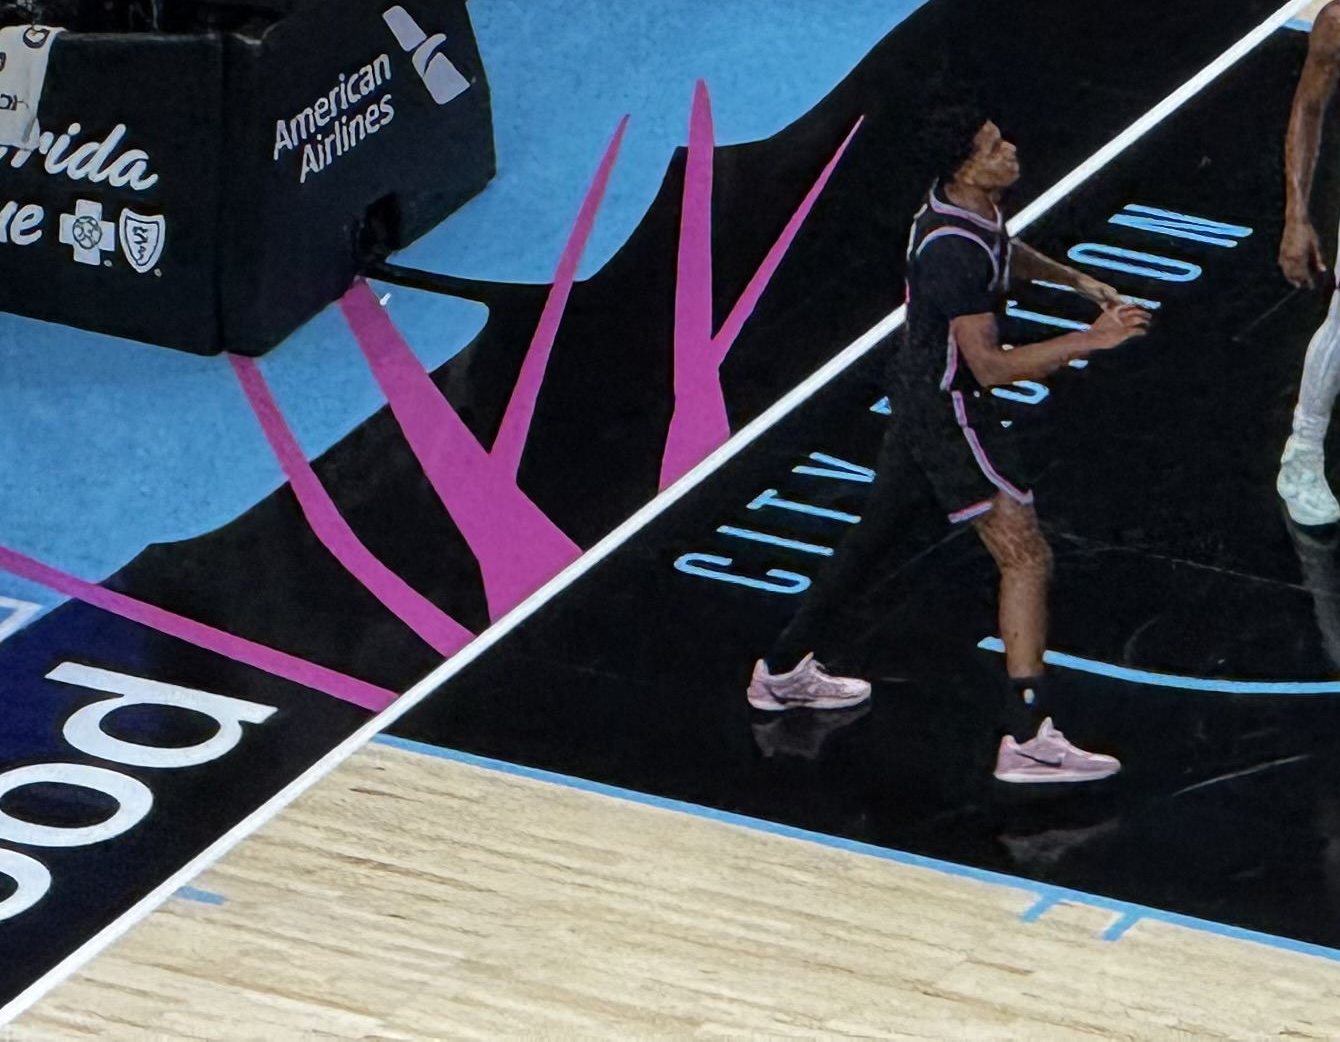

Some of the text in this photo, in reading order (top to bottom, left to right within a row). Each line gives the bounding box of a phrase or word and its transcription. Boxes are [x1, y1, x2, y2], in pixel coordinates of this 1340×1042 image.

[273, 53, 392, 160] American
[299, 93, 396, 184] Airlines
[673, 451, 877, 595] CITY
